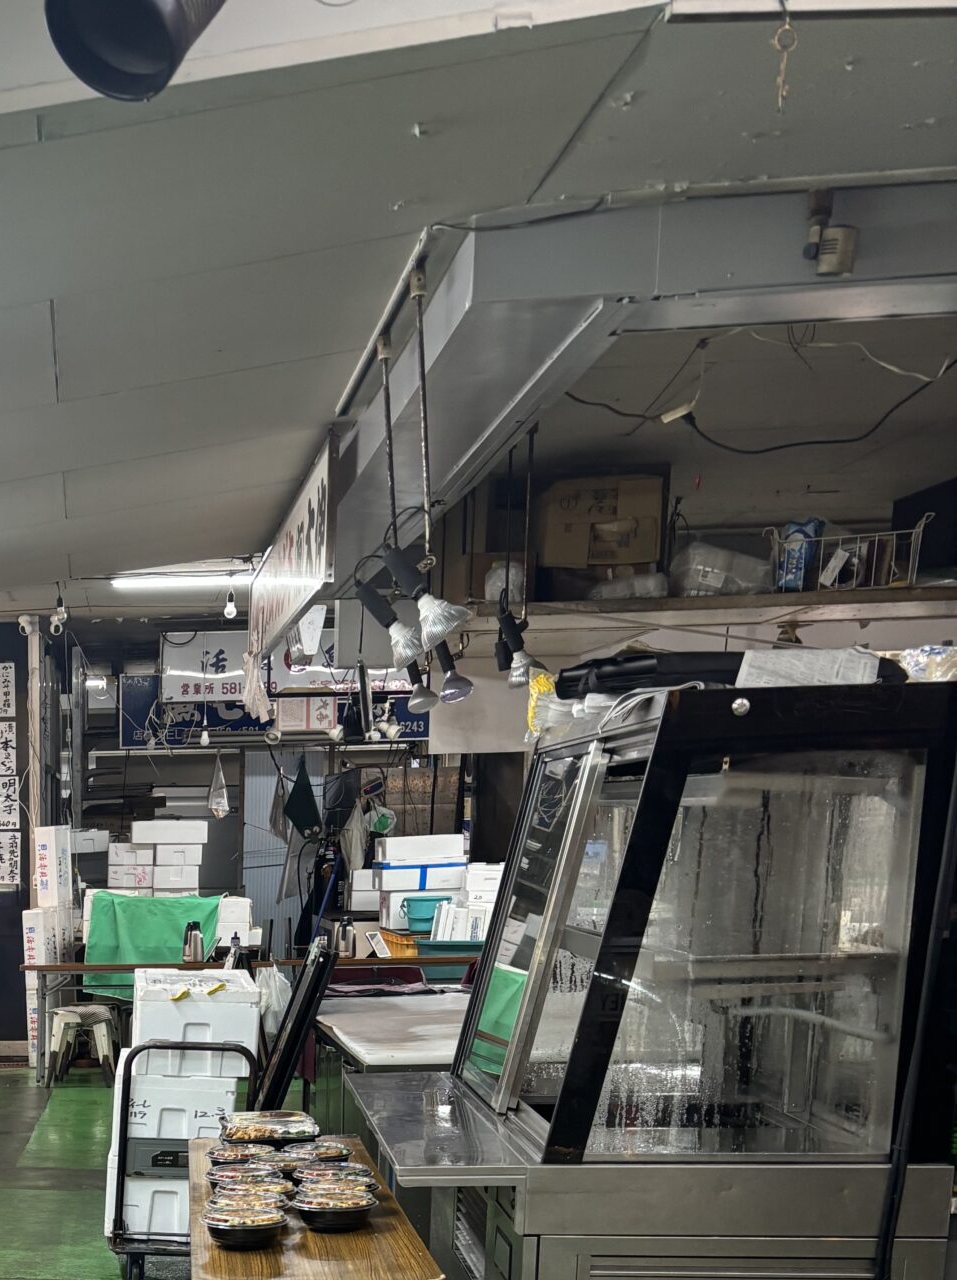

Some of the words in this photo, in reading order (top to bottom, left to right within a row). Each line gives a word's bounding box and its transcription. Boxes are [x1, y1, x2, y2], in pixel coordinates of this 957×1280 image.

[180, 682, 214, 695] 営業所
[0, 777, 18, 815] 明太子
